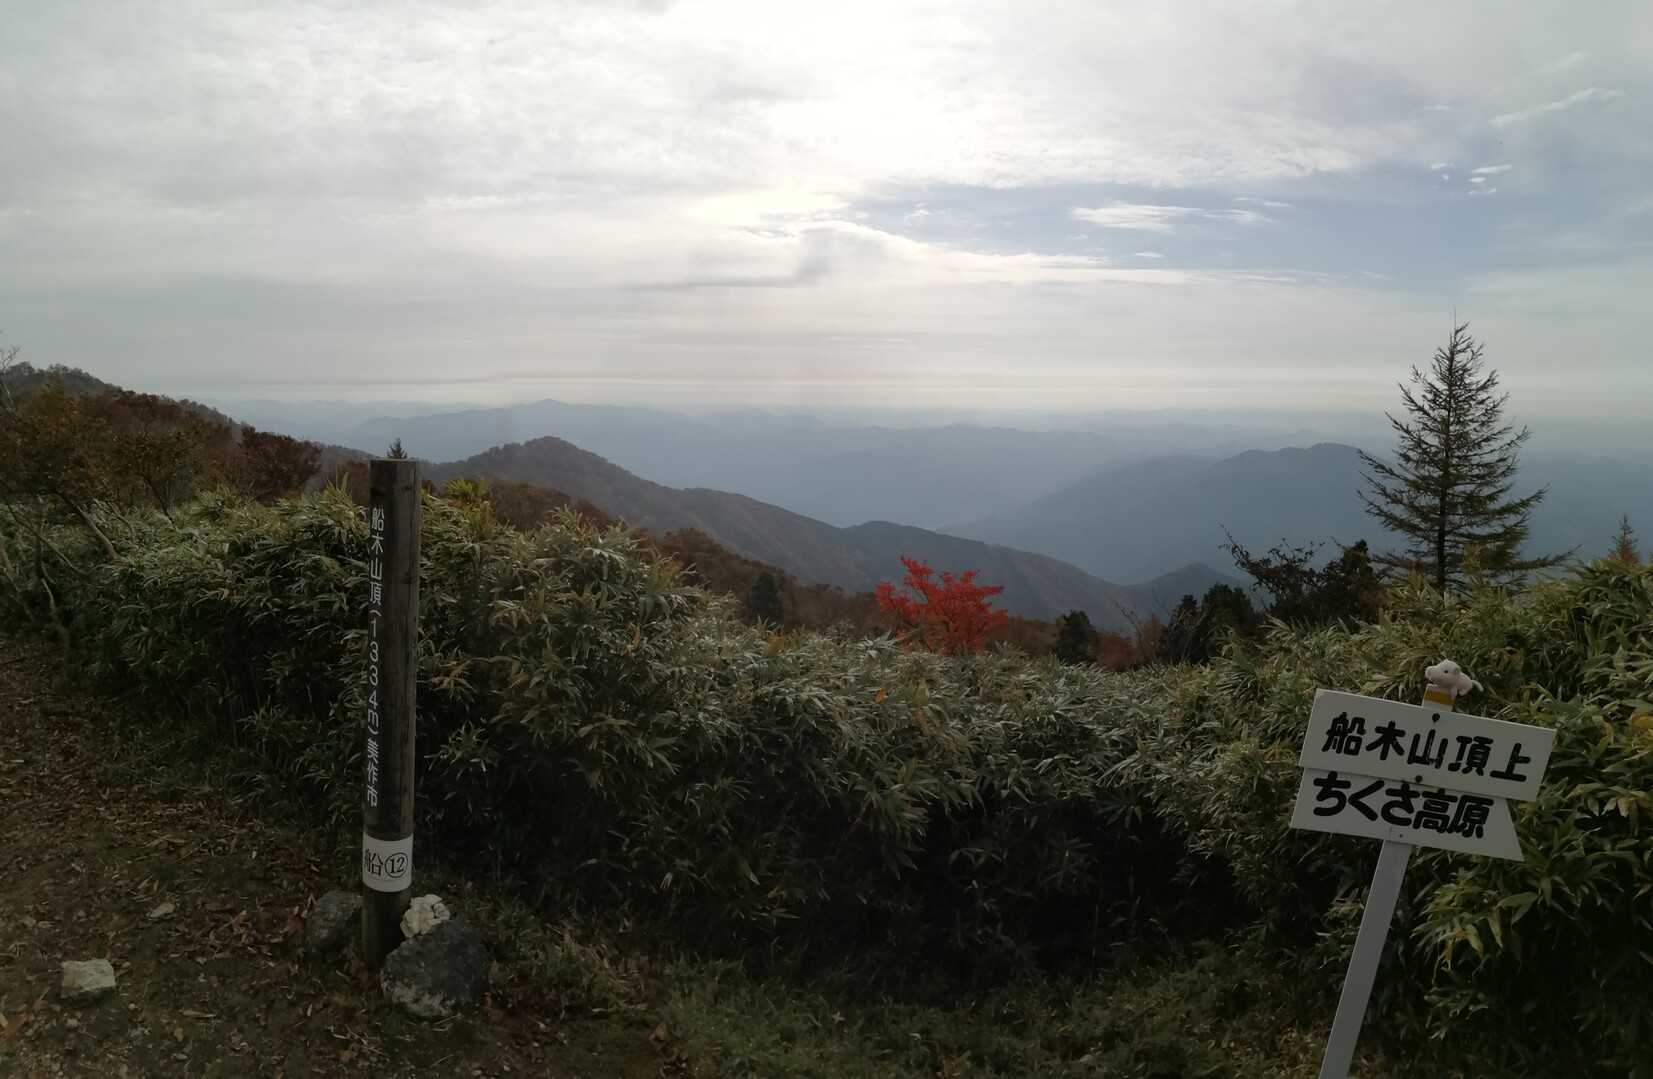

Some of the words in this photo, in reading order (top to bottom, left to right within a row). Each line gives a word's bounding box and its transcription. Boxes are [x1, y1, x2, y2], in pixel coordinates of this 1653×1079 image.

[1321, 711, 1531, 782] 船木山頂上
[1313, 770, 1494, 839] ちくさ高原
